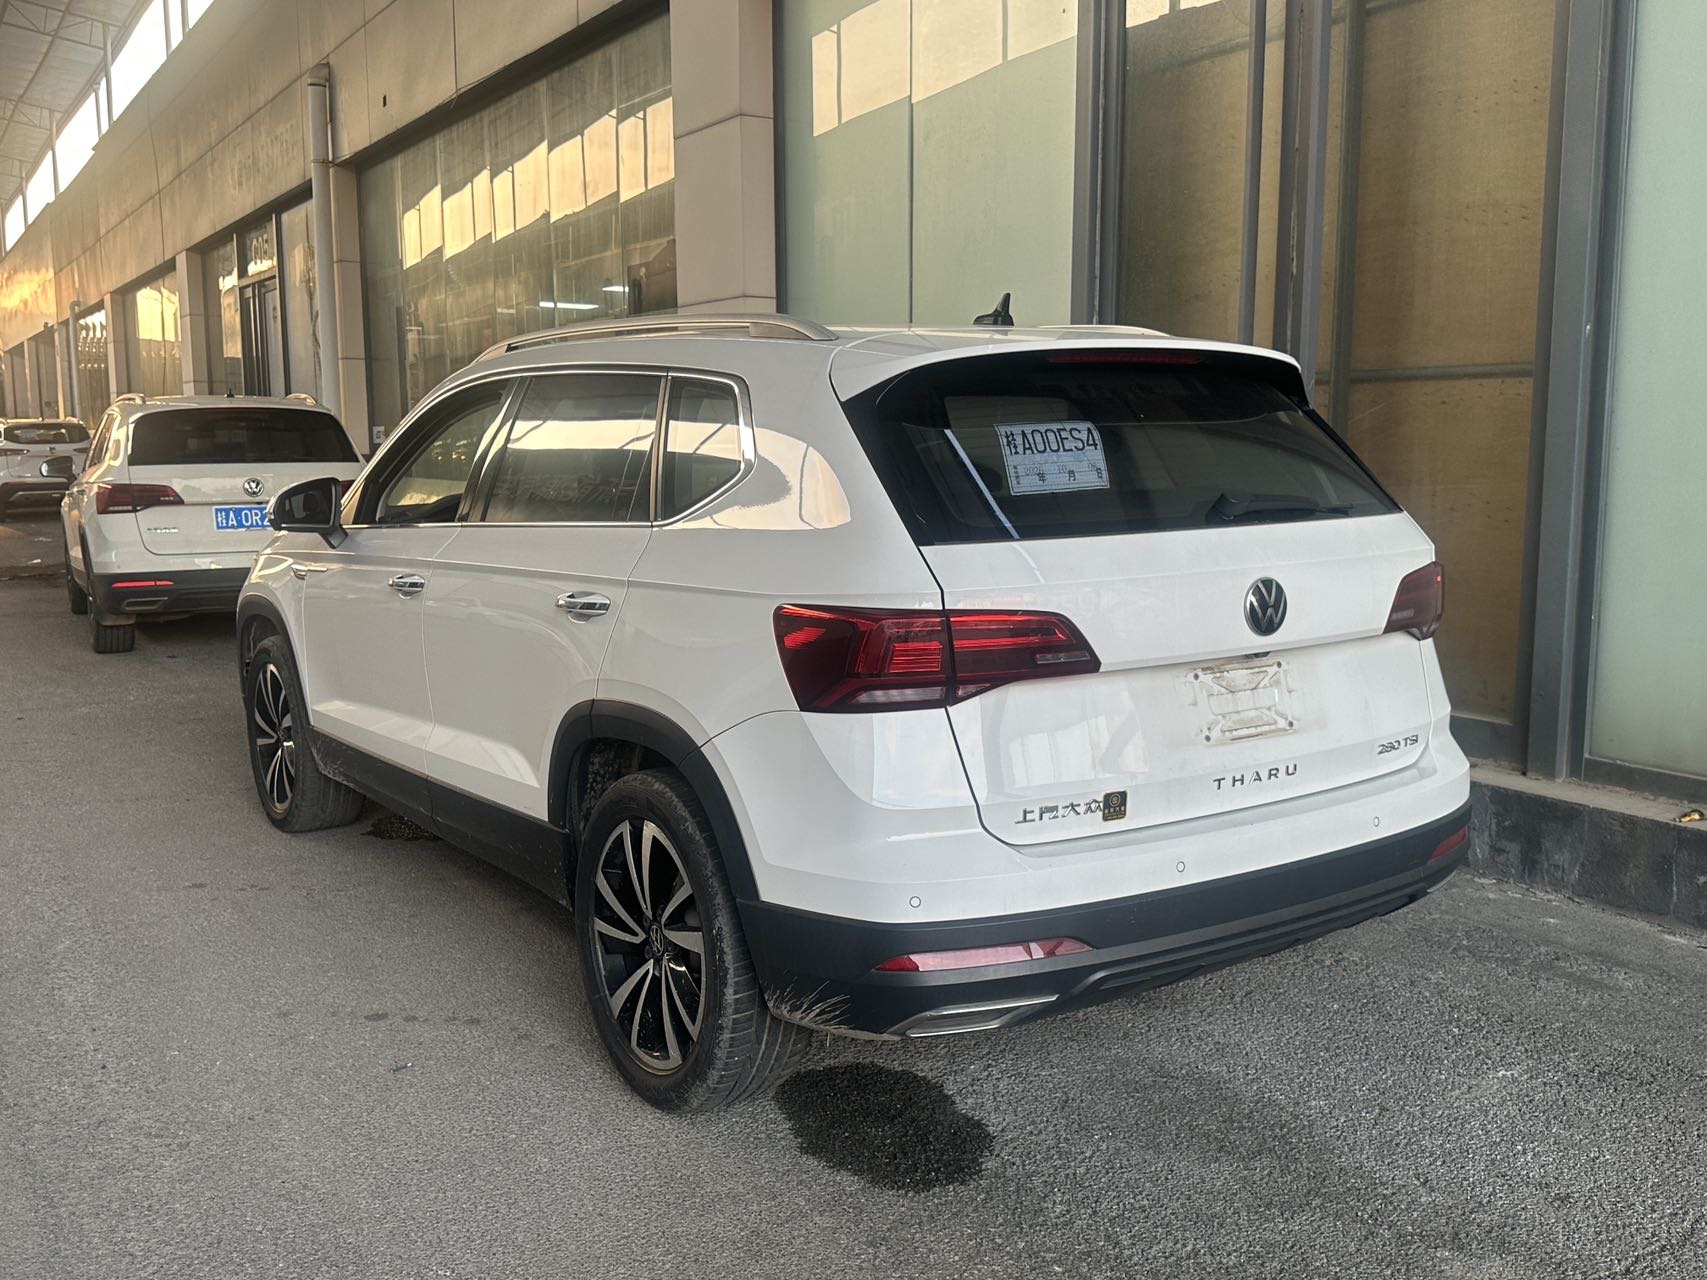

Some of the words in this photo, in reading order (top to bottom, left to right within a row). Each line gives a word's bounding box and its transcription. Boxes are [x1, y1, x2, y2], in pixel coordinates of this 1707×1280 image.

[1244, 577, 1287, 636] VW
[1213, 763, 1297, 790] THARU
[1015, 799, 1103, 824] 上汽大众
